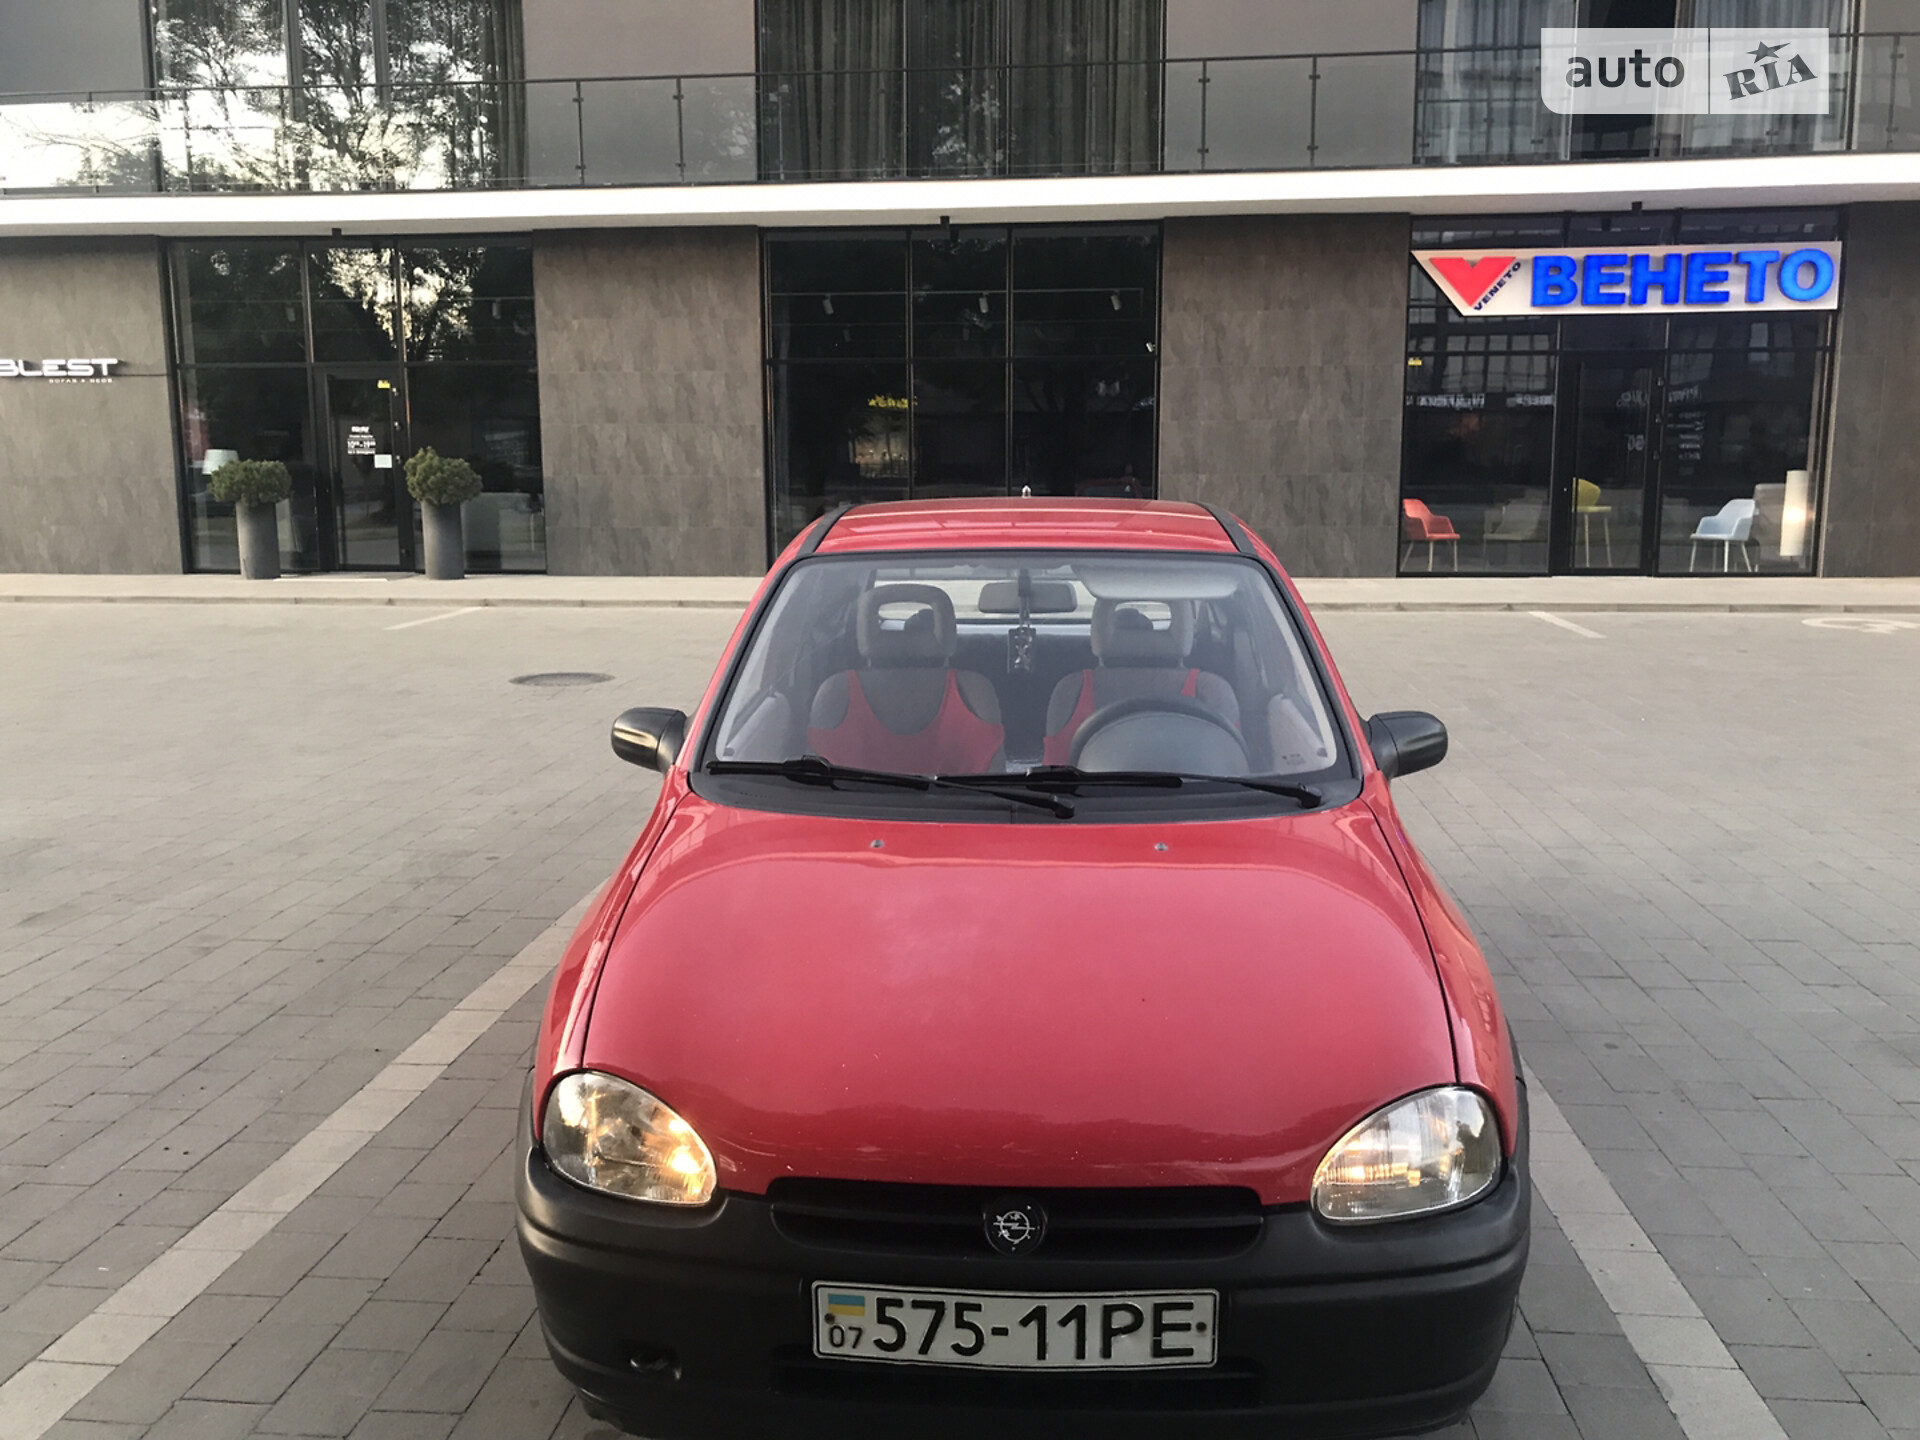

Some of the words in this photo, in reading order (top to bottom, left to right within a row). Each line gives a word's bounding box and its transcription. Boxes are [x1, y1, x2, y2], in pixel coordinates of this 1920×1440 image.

[1474, 261, 1521, 311] VENETO
[1531, 248, 1835, 307] ВЕНЕТО
[829, 1324, 863, 1349] 07
[873, 1297, 1195, 1361] 575-11PE
